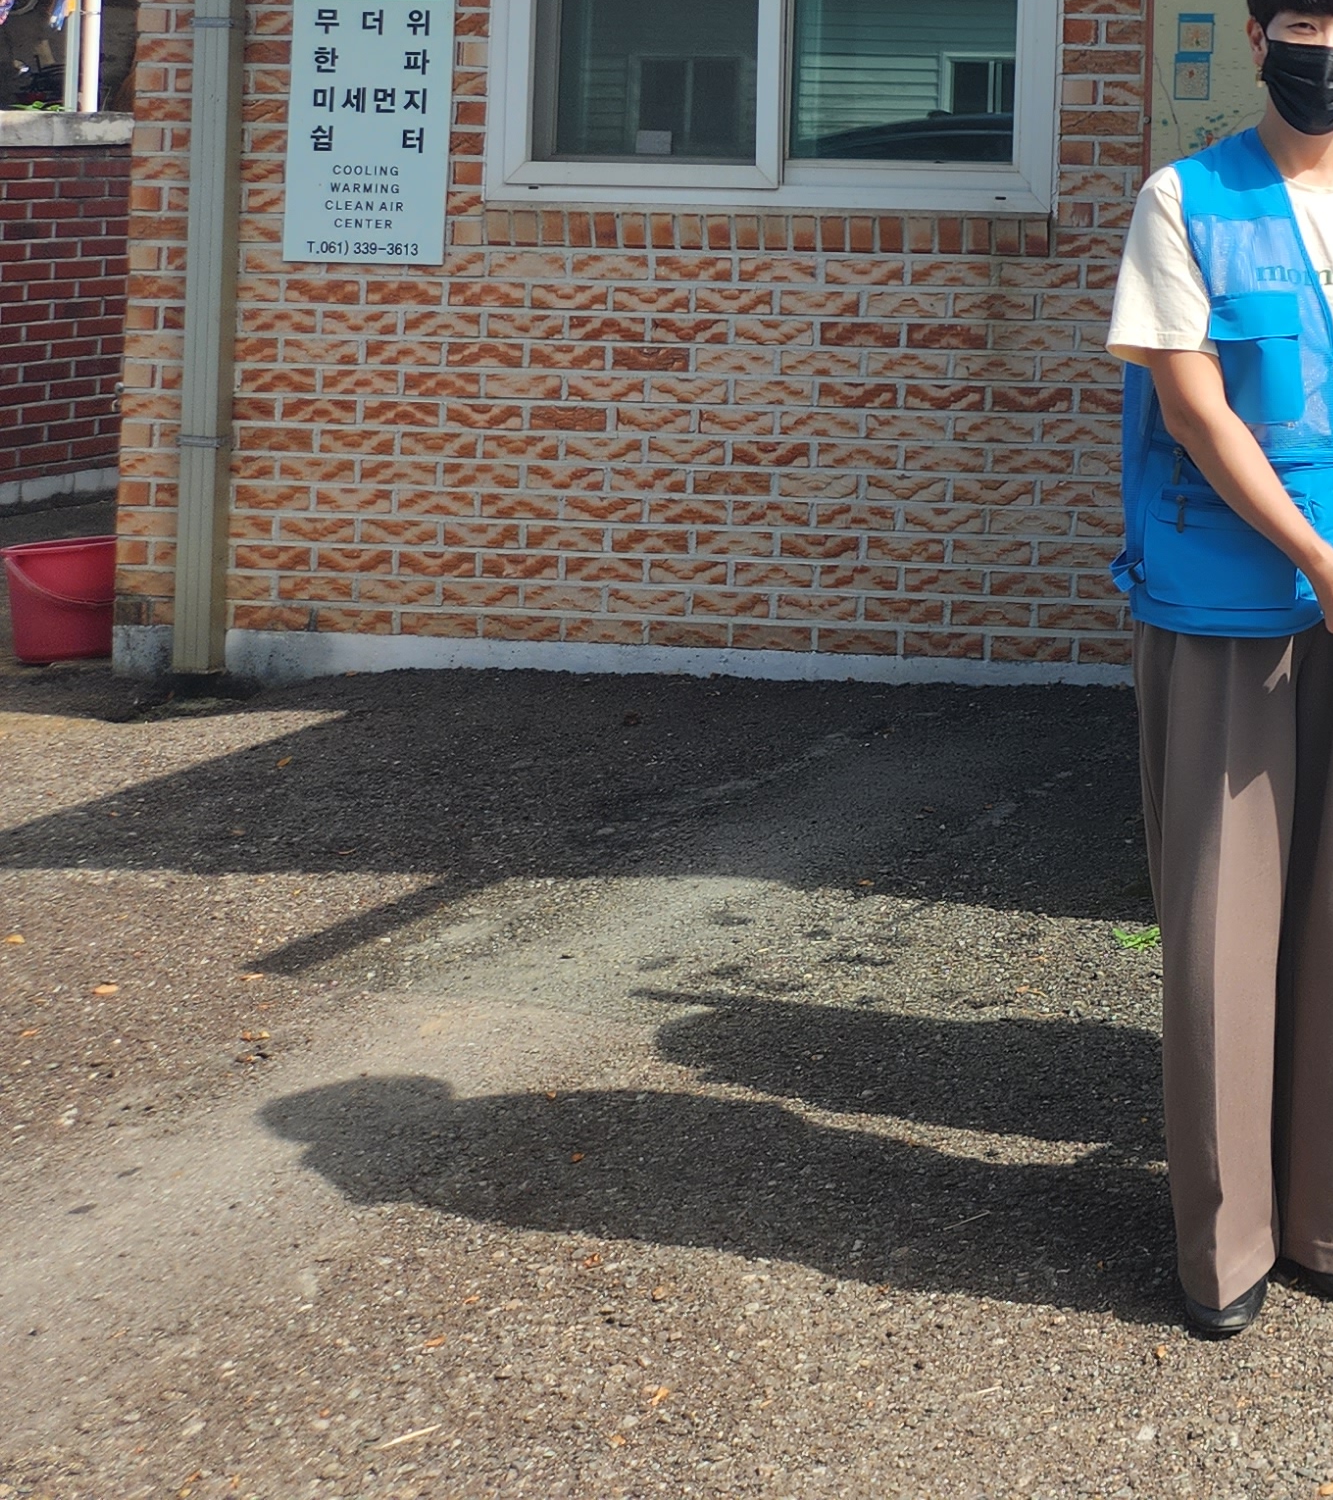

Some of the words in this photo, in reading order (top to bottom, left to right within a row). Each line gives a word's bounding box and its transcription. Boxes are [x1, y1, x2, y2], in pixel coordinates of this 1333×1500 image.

[312, 86, 427, 114] 미세먼지
[332, 164, 399, 176] COOLING
[330, 182, 400, 194] WARMING
[324, 199, 374, 211] CLEAN
[378, 201, 404, 212] AIR
[334, 218, 393, 229] CENTER
[353, 241, 419, 256] 339-3613
